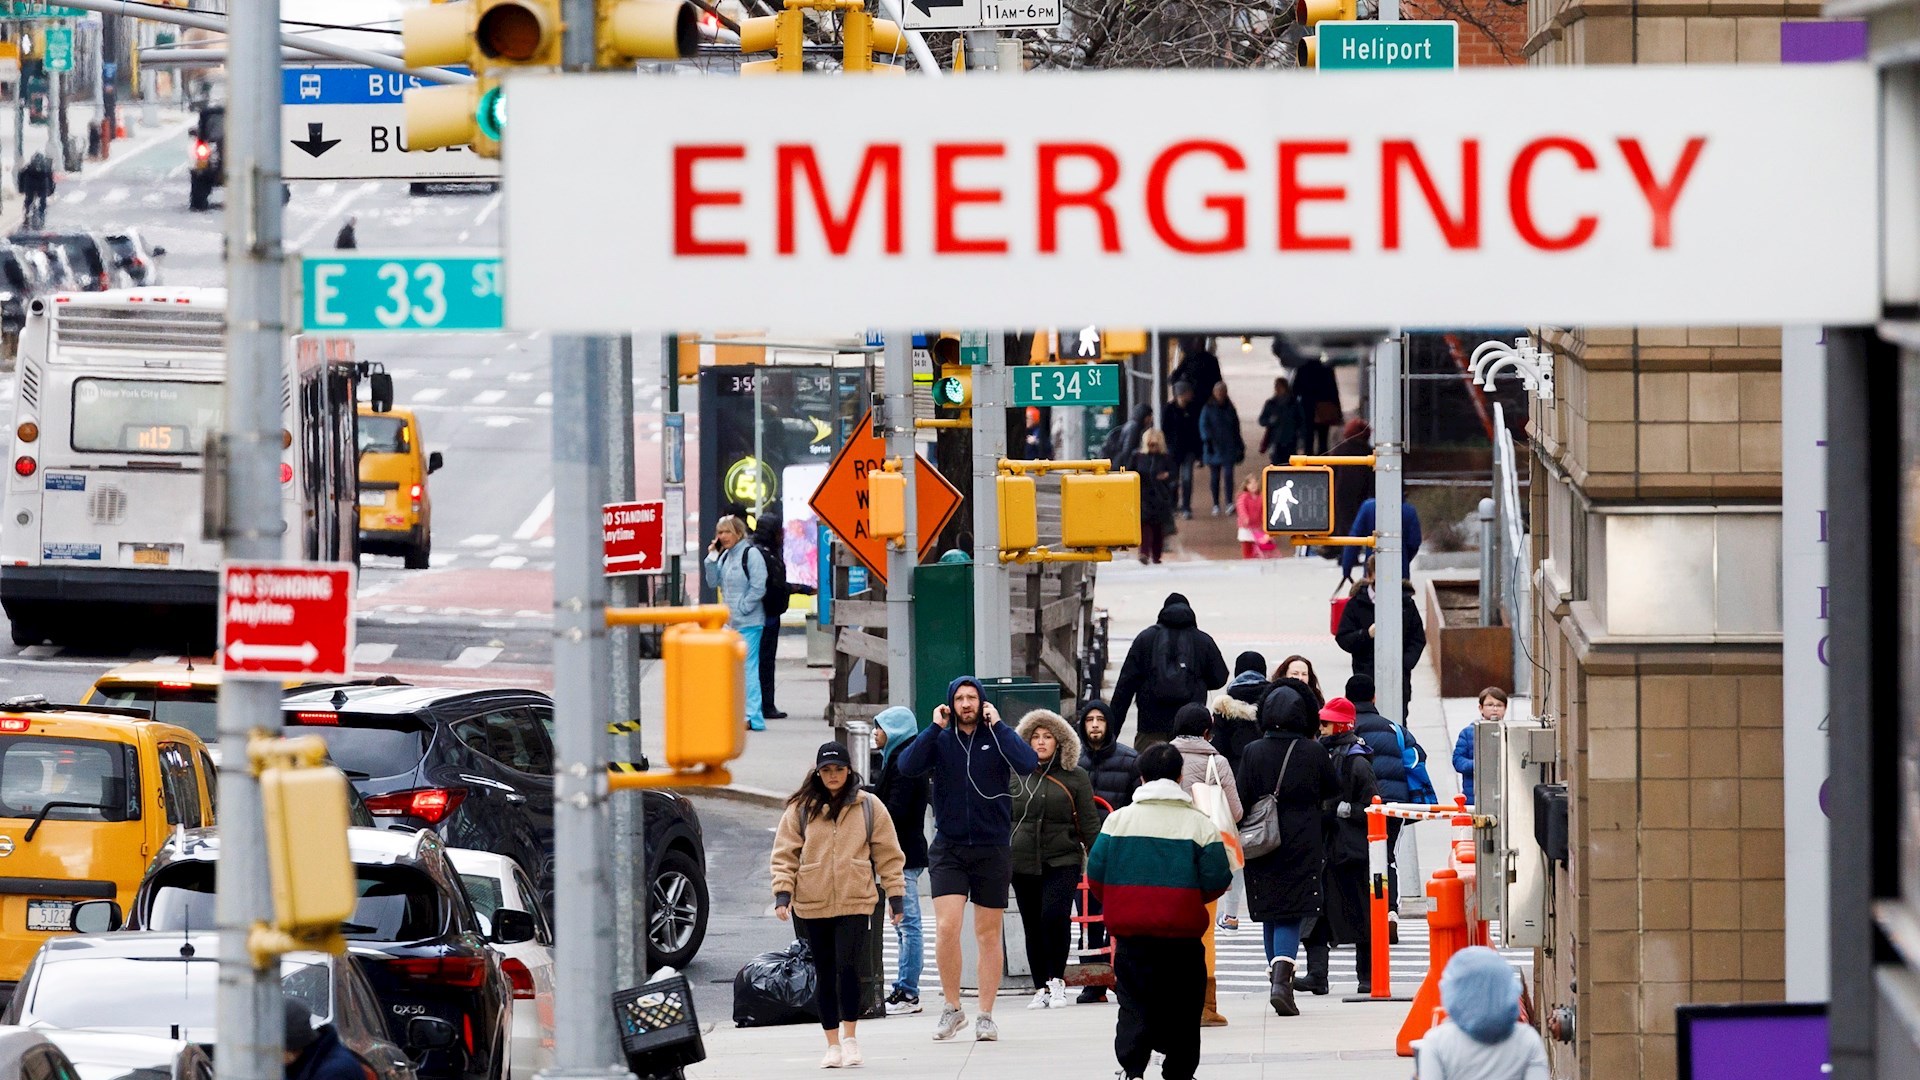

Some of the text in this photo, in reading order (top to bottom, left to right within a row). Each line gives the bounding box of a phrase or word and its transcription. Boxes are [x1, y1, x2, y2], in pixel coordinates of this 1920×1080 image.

[1342, 37, 1432, 65] Heliport
[672, 136, 1706, 257] EMERGENCY
[314, 263, 347, 327] E
[374, 262, 448, 328] 33
[120, 388, 139, 398] York
[140, 388, 159, 400] City
[160, 389, 178, 400] Bus
[1031, 368, 1102, 401] E 34 St
[809, 444, 832, 455] Sprint
[614, 508, 656, 526] STANDING
[228, 573, 333, 601] NO STANDING
[229, 599, 295, 629] Anytime
[40, 909, 71, 924] 5J23
[392, 1004, 426, 1016] QX50
